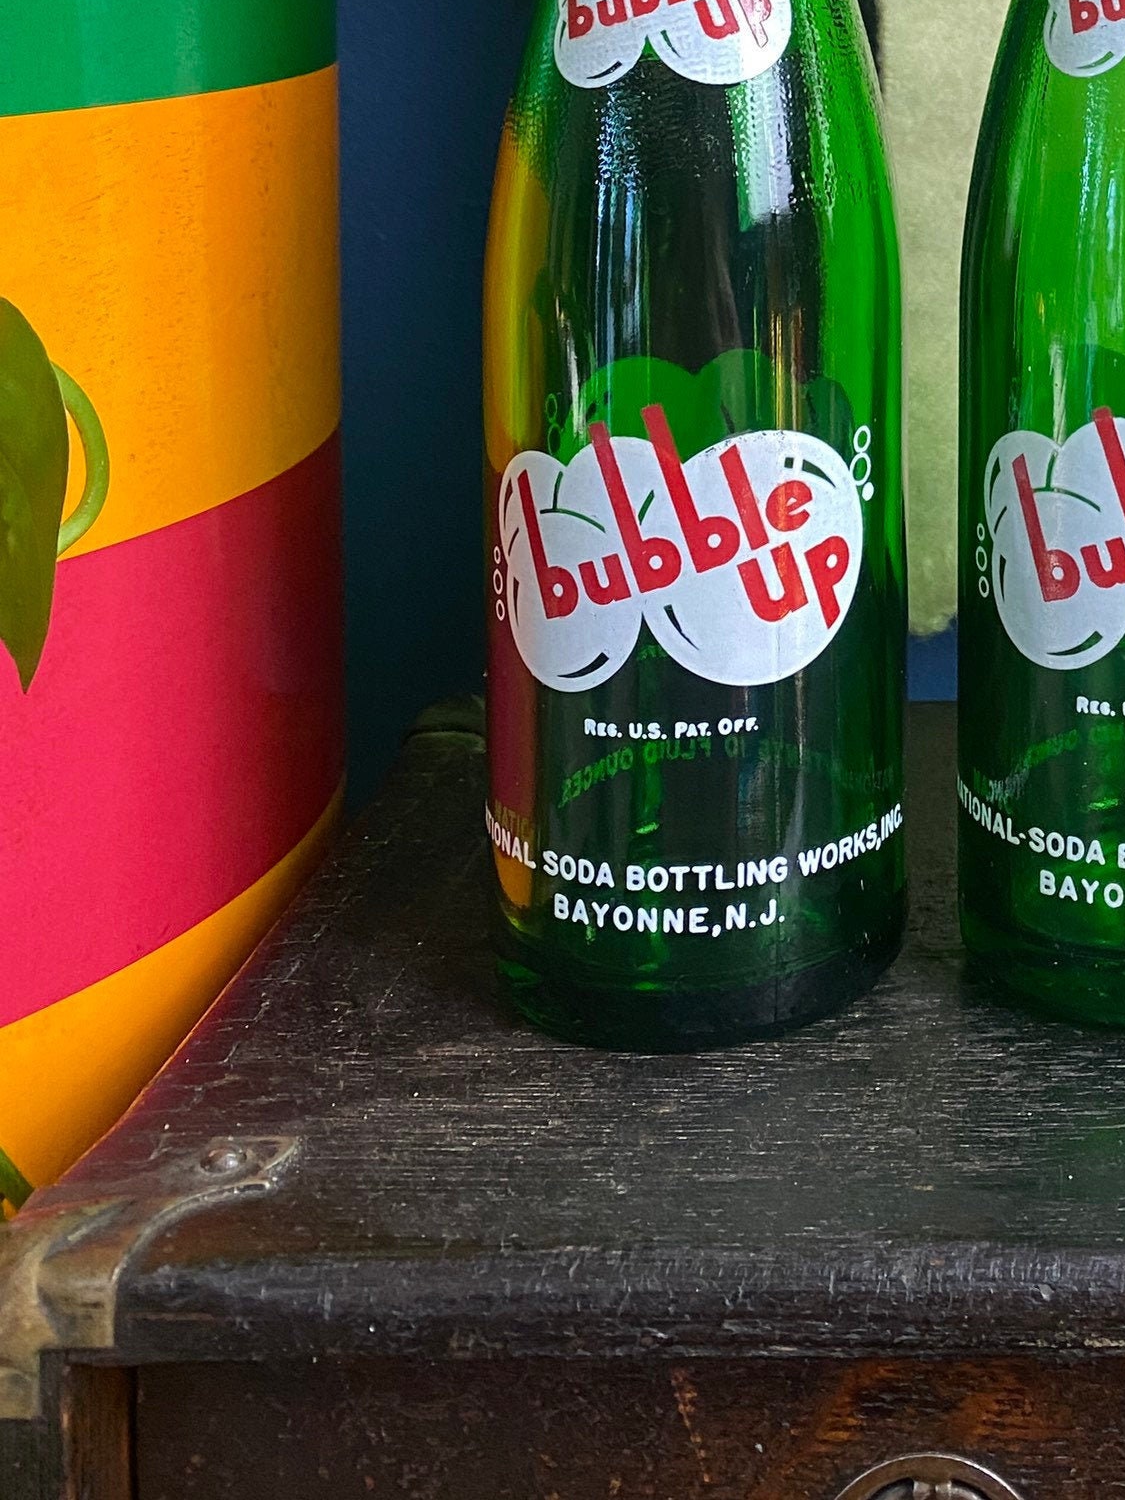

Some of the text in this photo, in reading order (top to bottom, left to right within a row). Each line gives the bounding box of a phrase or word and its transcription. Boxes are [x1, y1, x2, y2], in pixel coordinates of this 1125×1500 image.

[517, 403, 813, 619] bubble
[485, 799, 537, 870] TIONAL
[542, 850, 615, 888] SODA
[626, 856, 788, 893] BOTTLING
